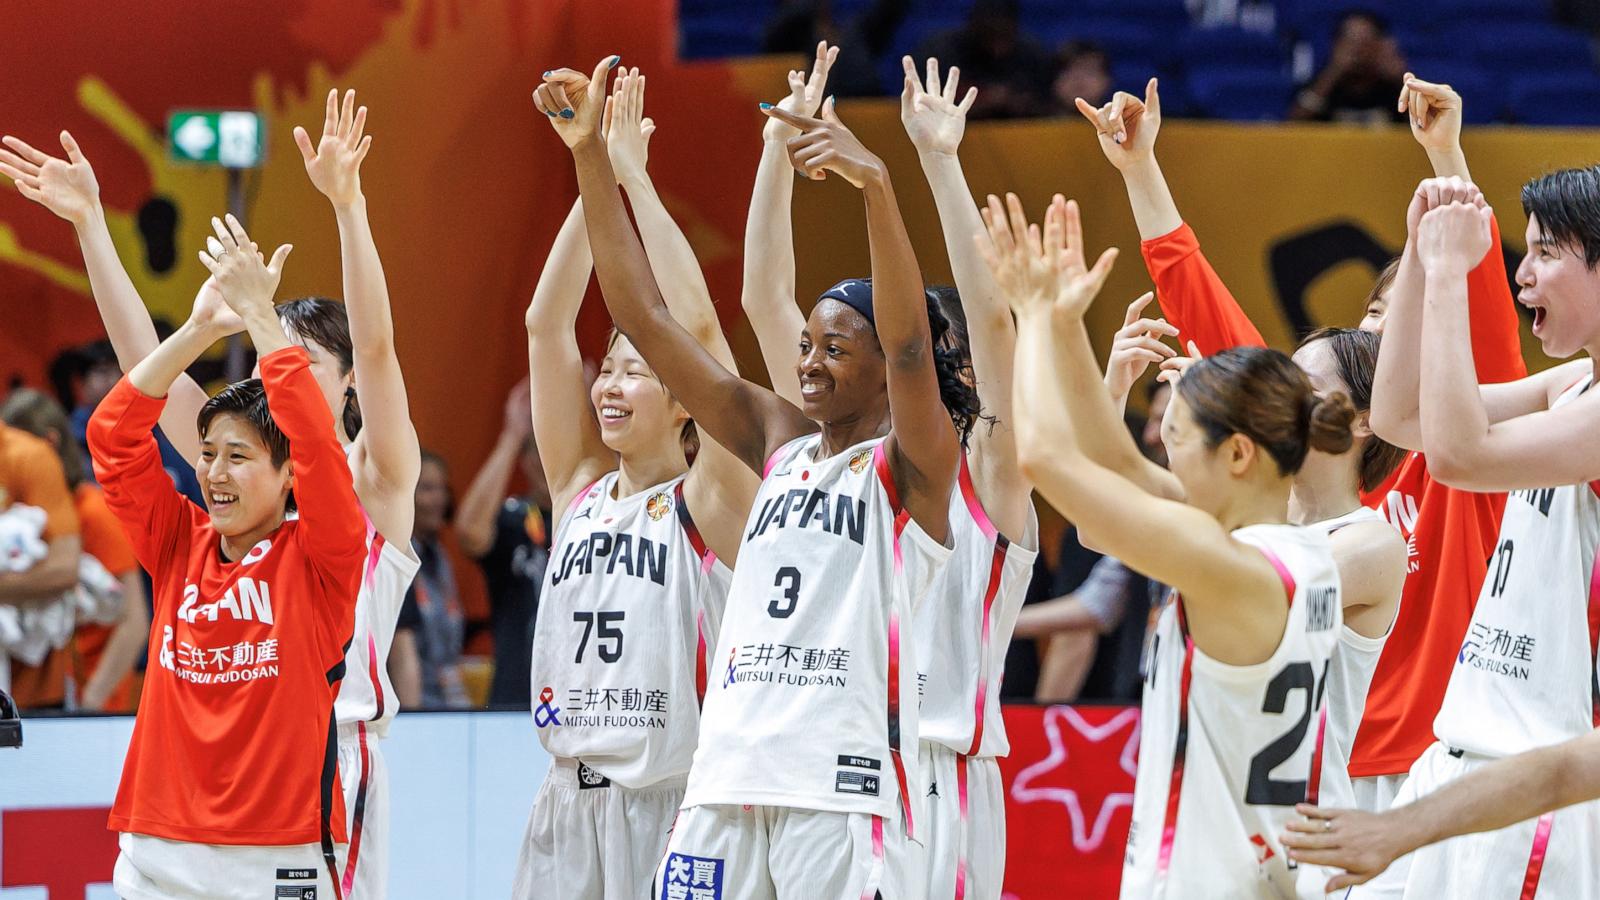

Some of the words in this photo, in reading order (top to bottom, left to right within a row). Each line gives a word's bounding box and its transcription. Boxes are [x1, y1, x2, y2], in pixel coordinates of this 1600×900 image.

[747, 488, 866, 546] JAPAN
[552, 531, 668, 587] JAPAN
[767, 566, 801, 619] 3
[573, 611, 625, 664] 75
[177, 638, 279, 671] 三井不動産
[737, 643, 850, 671] 三井不動産
[214, 664, 279, 684] FUDOSAN
[736, 670, 773, 683] MITSUI
[778, 672, 846, 687] FUDOSAN
[566, 687, 669, 713] 三井不動産
[563, 715, 600, 728] MITSUI
[604, 715, 667, 729] FUDOSAN
